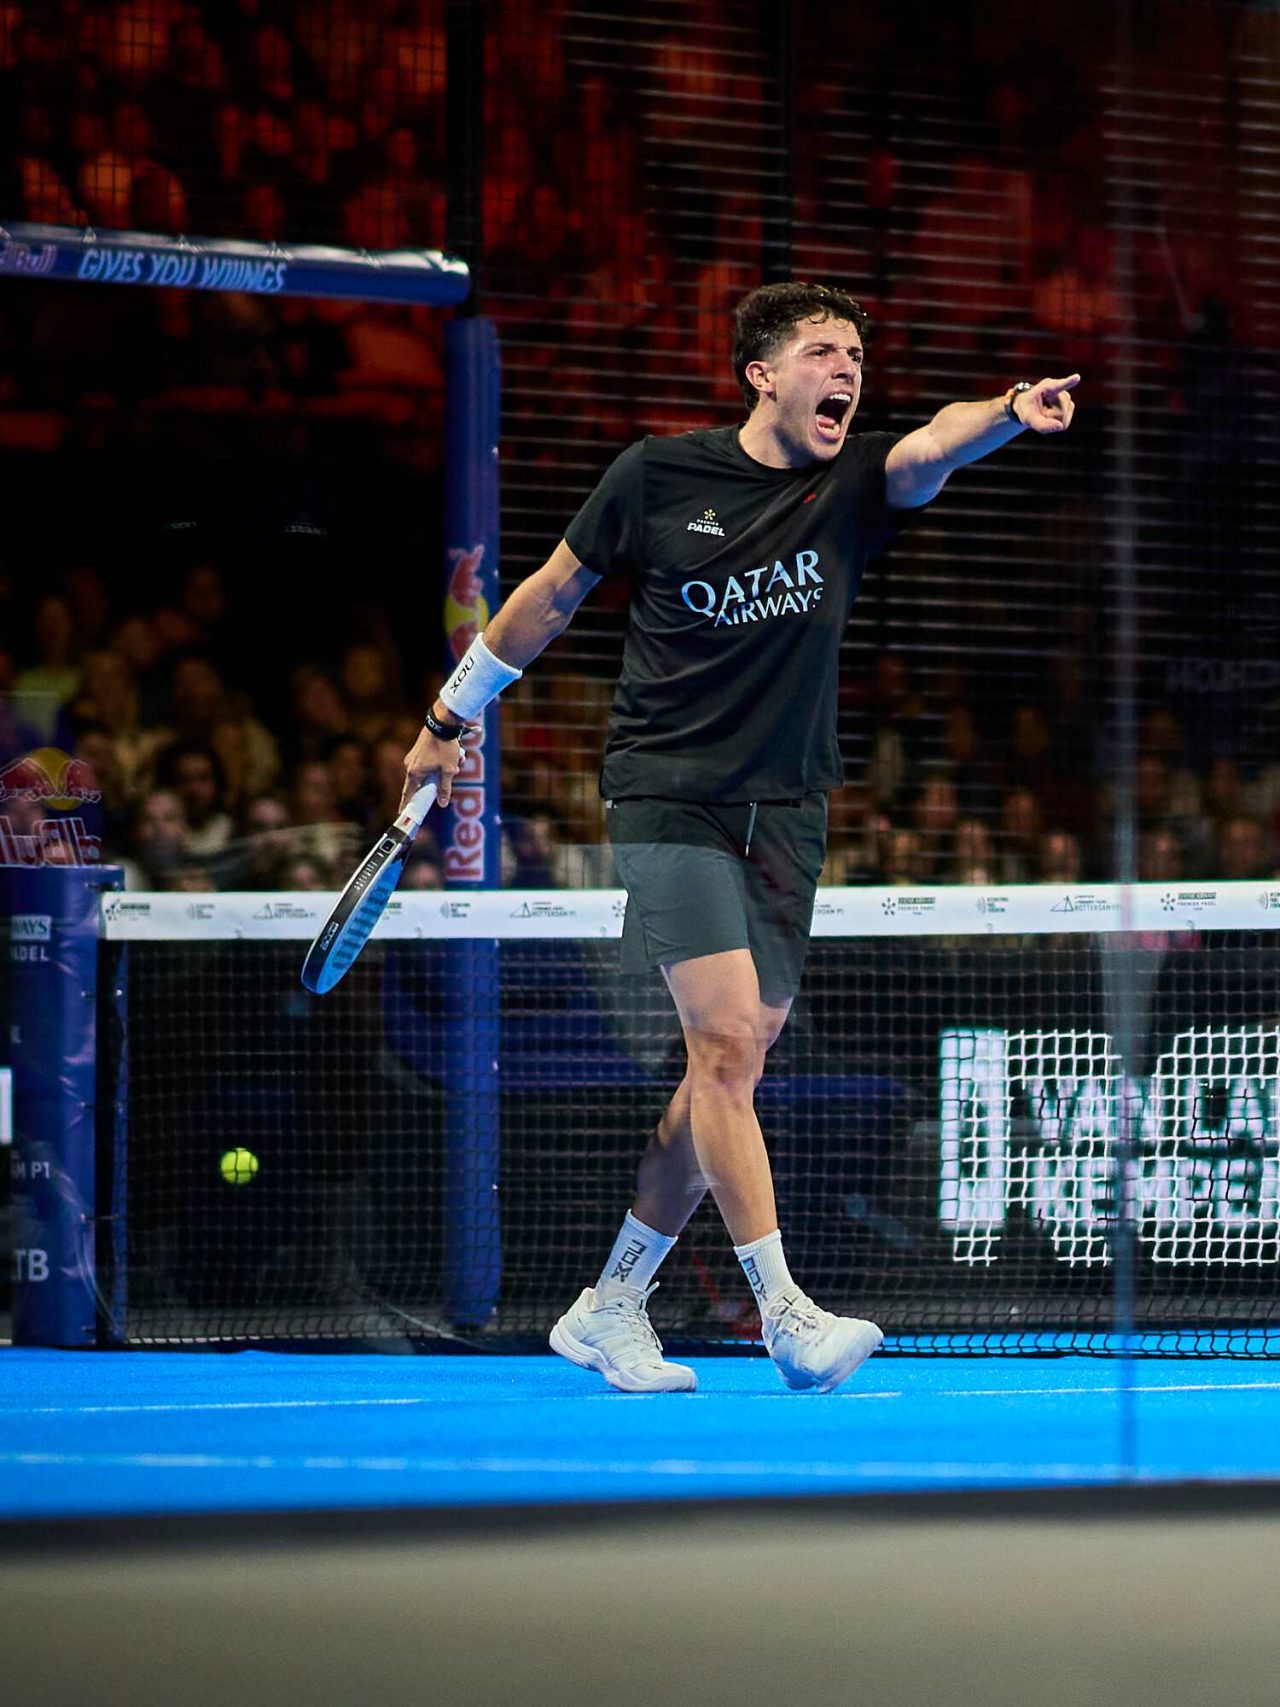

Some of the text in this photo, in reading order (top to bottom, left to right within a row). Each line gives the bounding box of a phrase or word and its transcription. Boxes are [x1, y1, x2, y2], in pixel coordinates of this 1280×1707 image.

[76, 248, 141, 282] GIVES
[146, 253, 196, 286] YOU
[687, 522, 725, 537] PADEL
[682, 550, 824, 617] QATAR
